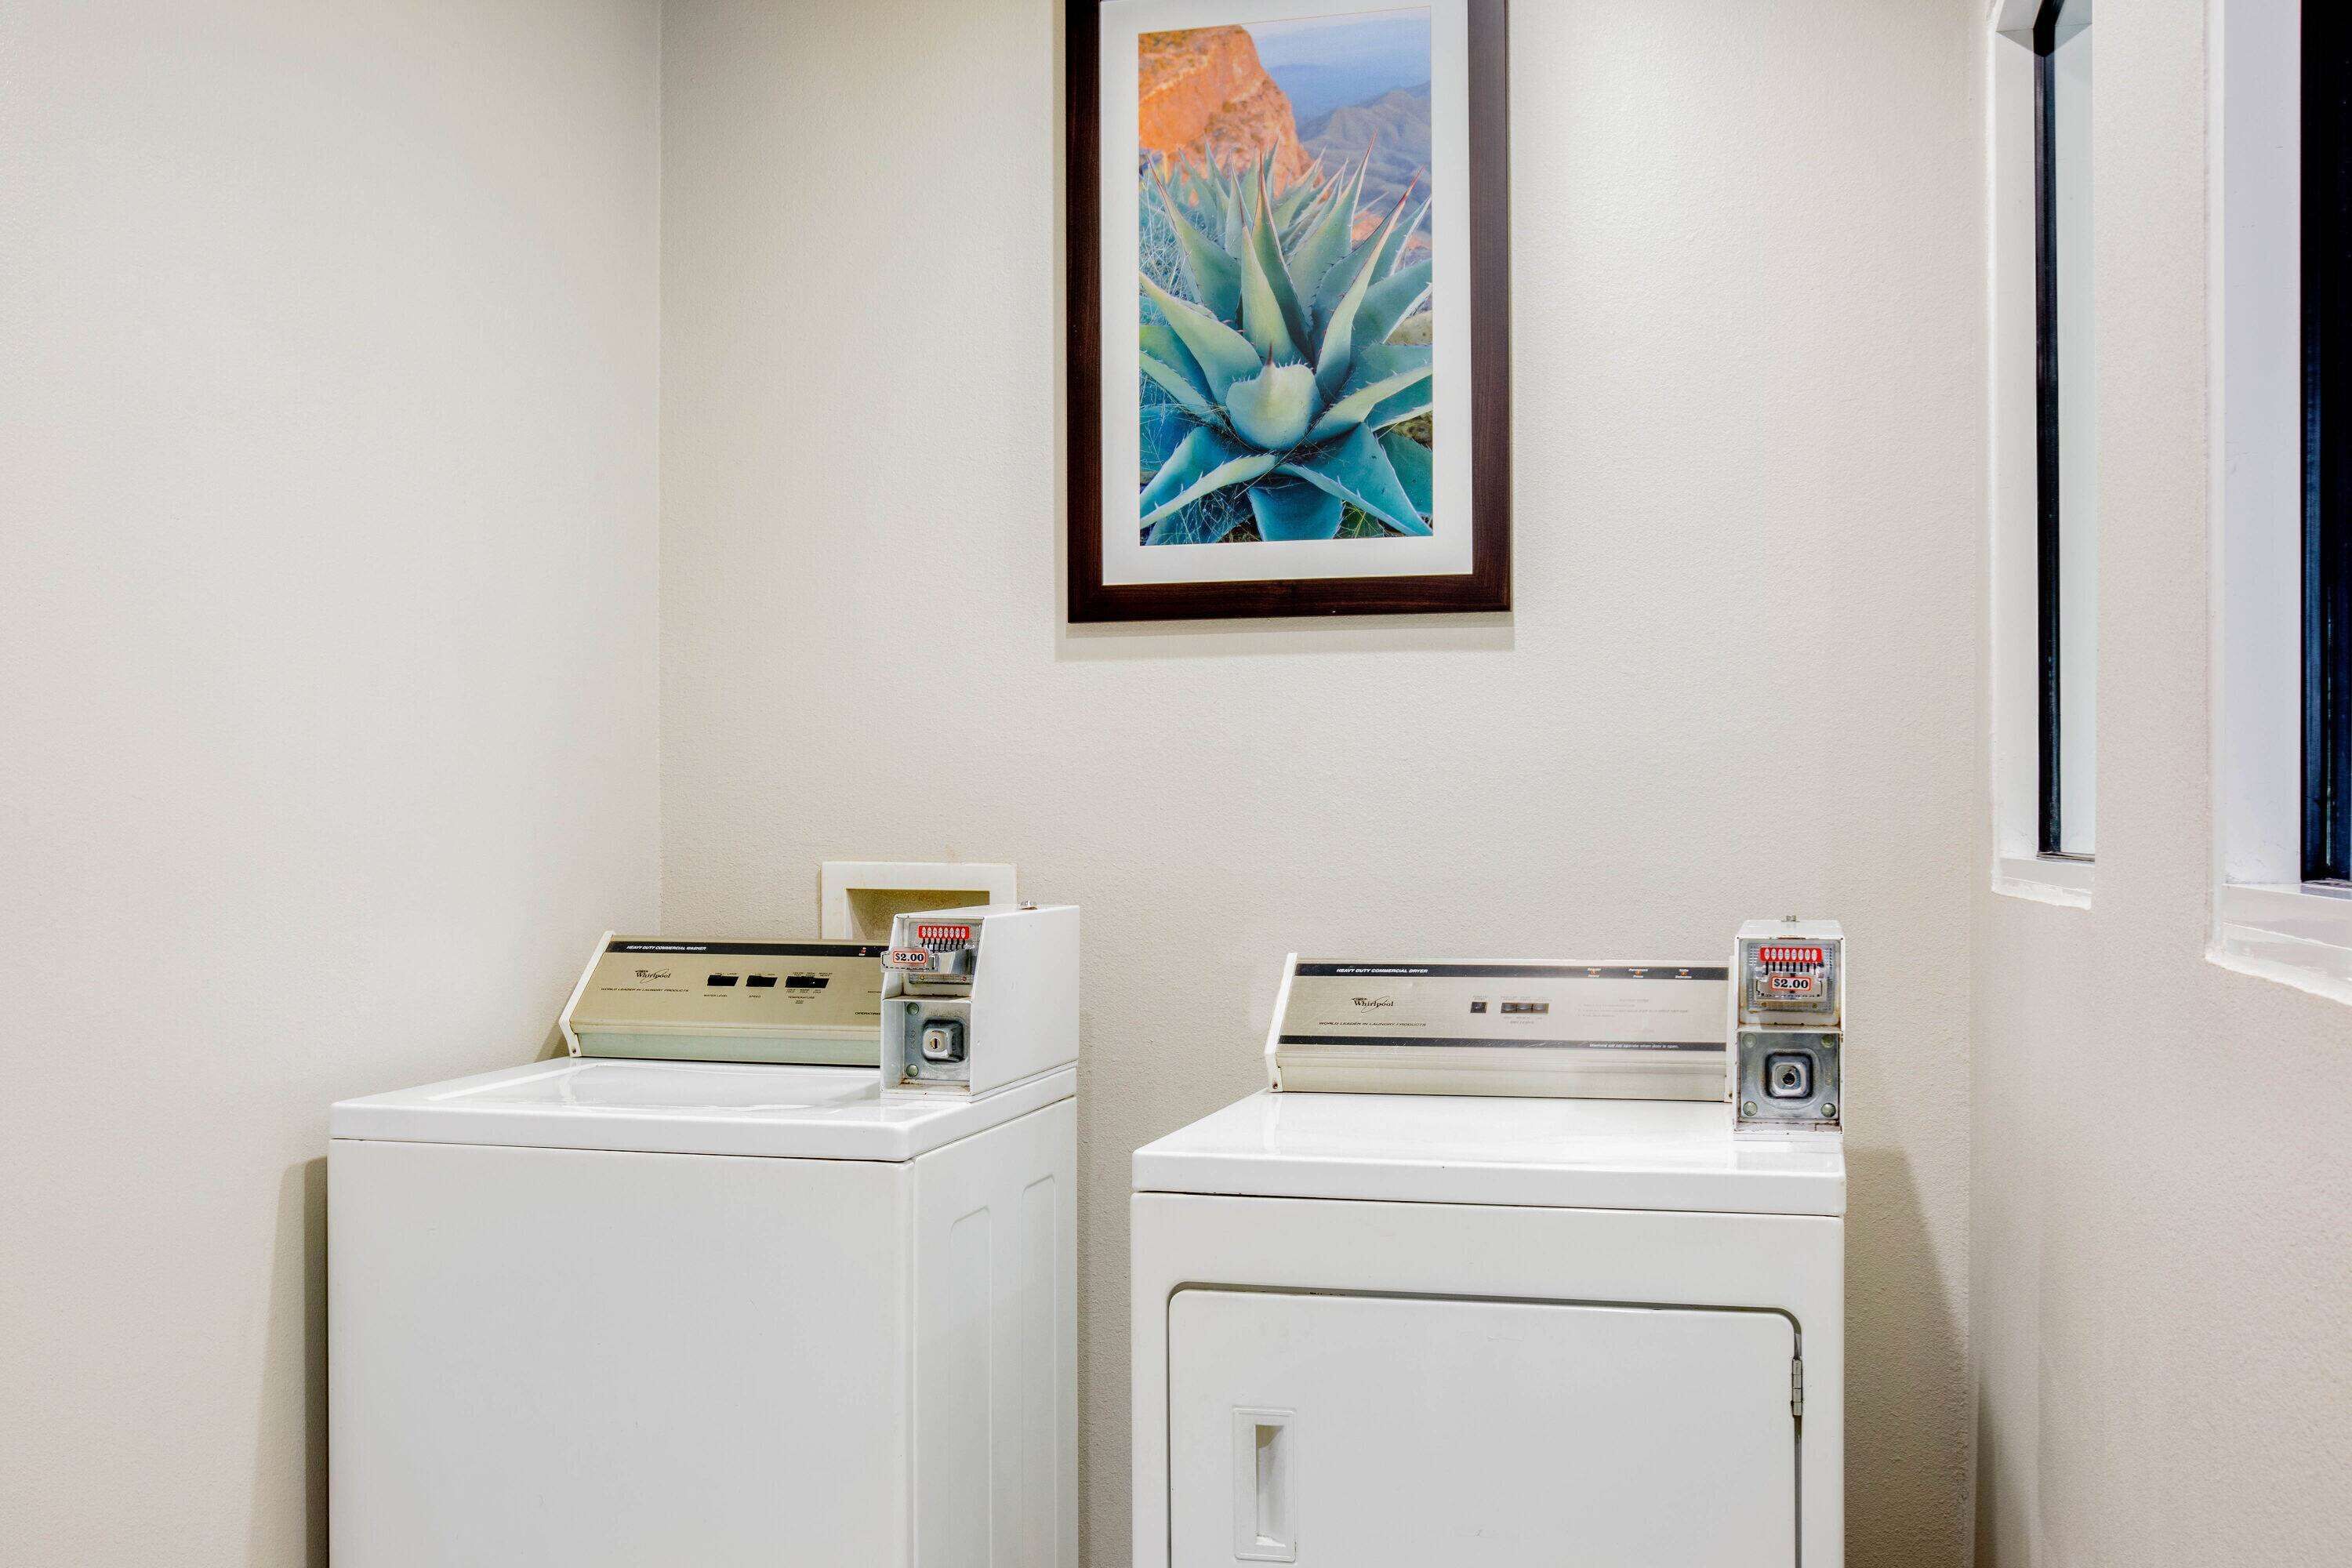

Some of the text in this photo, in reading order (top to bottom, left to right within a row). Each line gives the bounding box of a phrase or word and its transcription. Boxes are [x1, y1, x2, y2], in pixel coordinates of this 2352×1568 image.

[895, 953, 924, 962] $2.00
[1773, 978, 1809, 989] $2.00
[1353, 1000, 1394, 1008] Whirlpool
